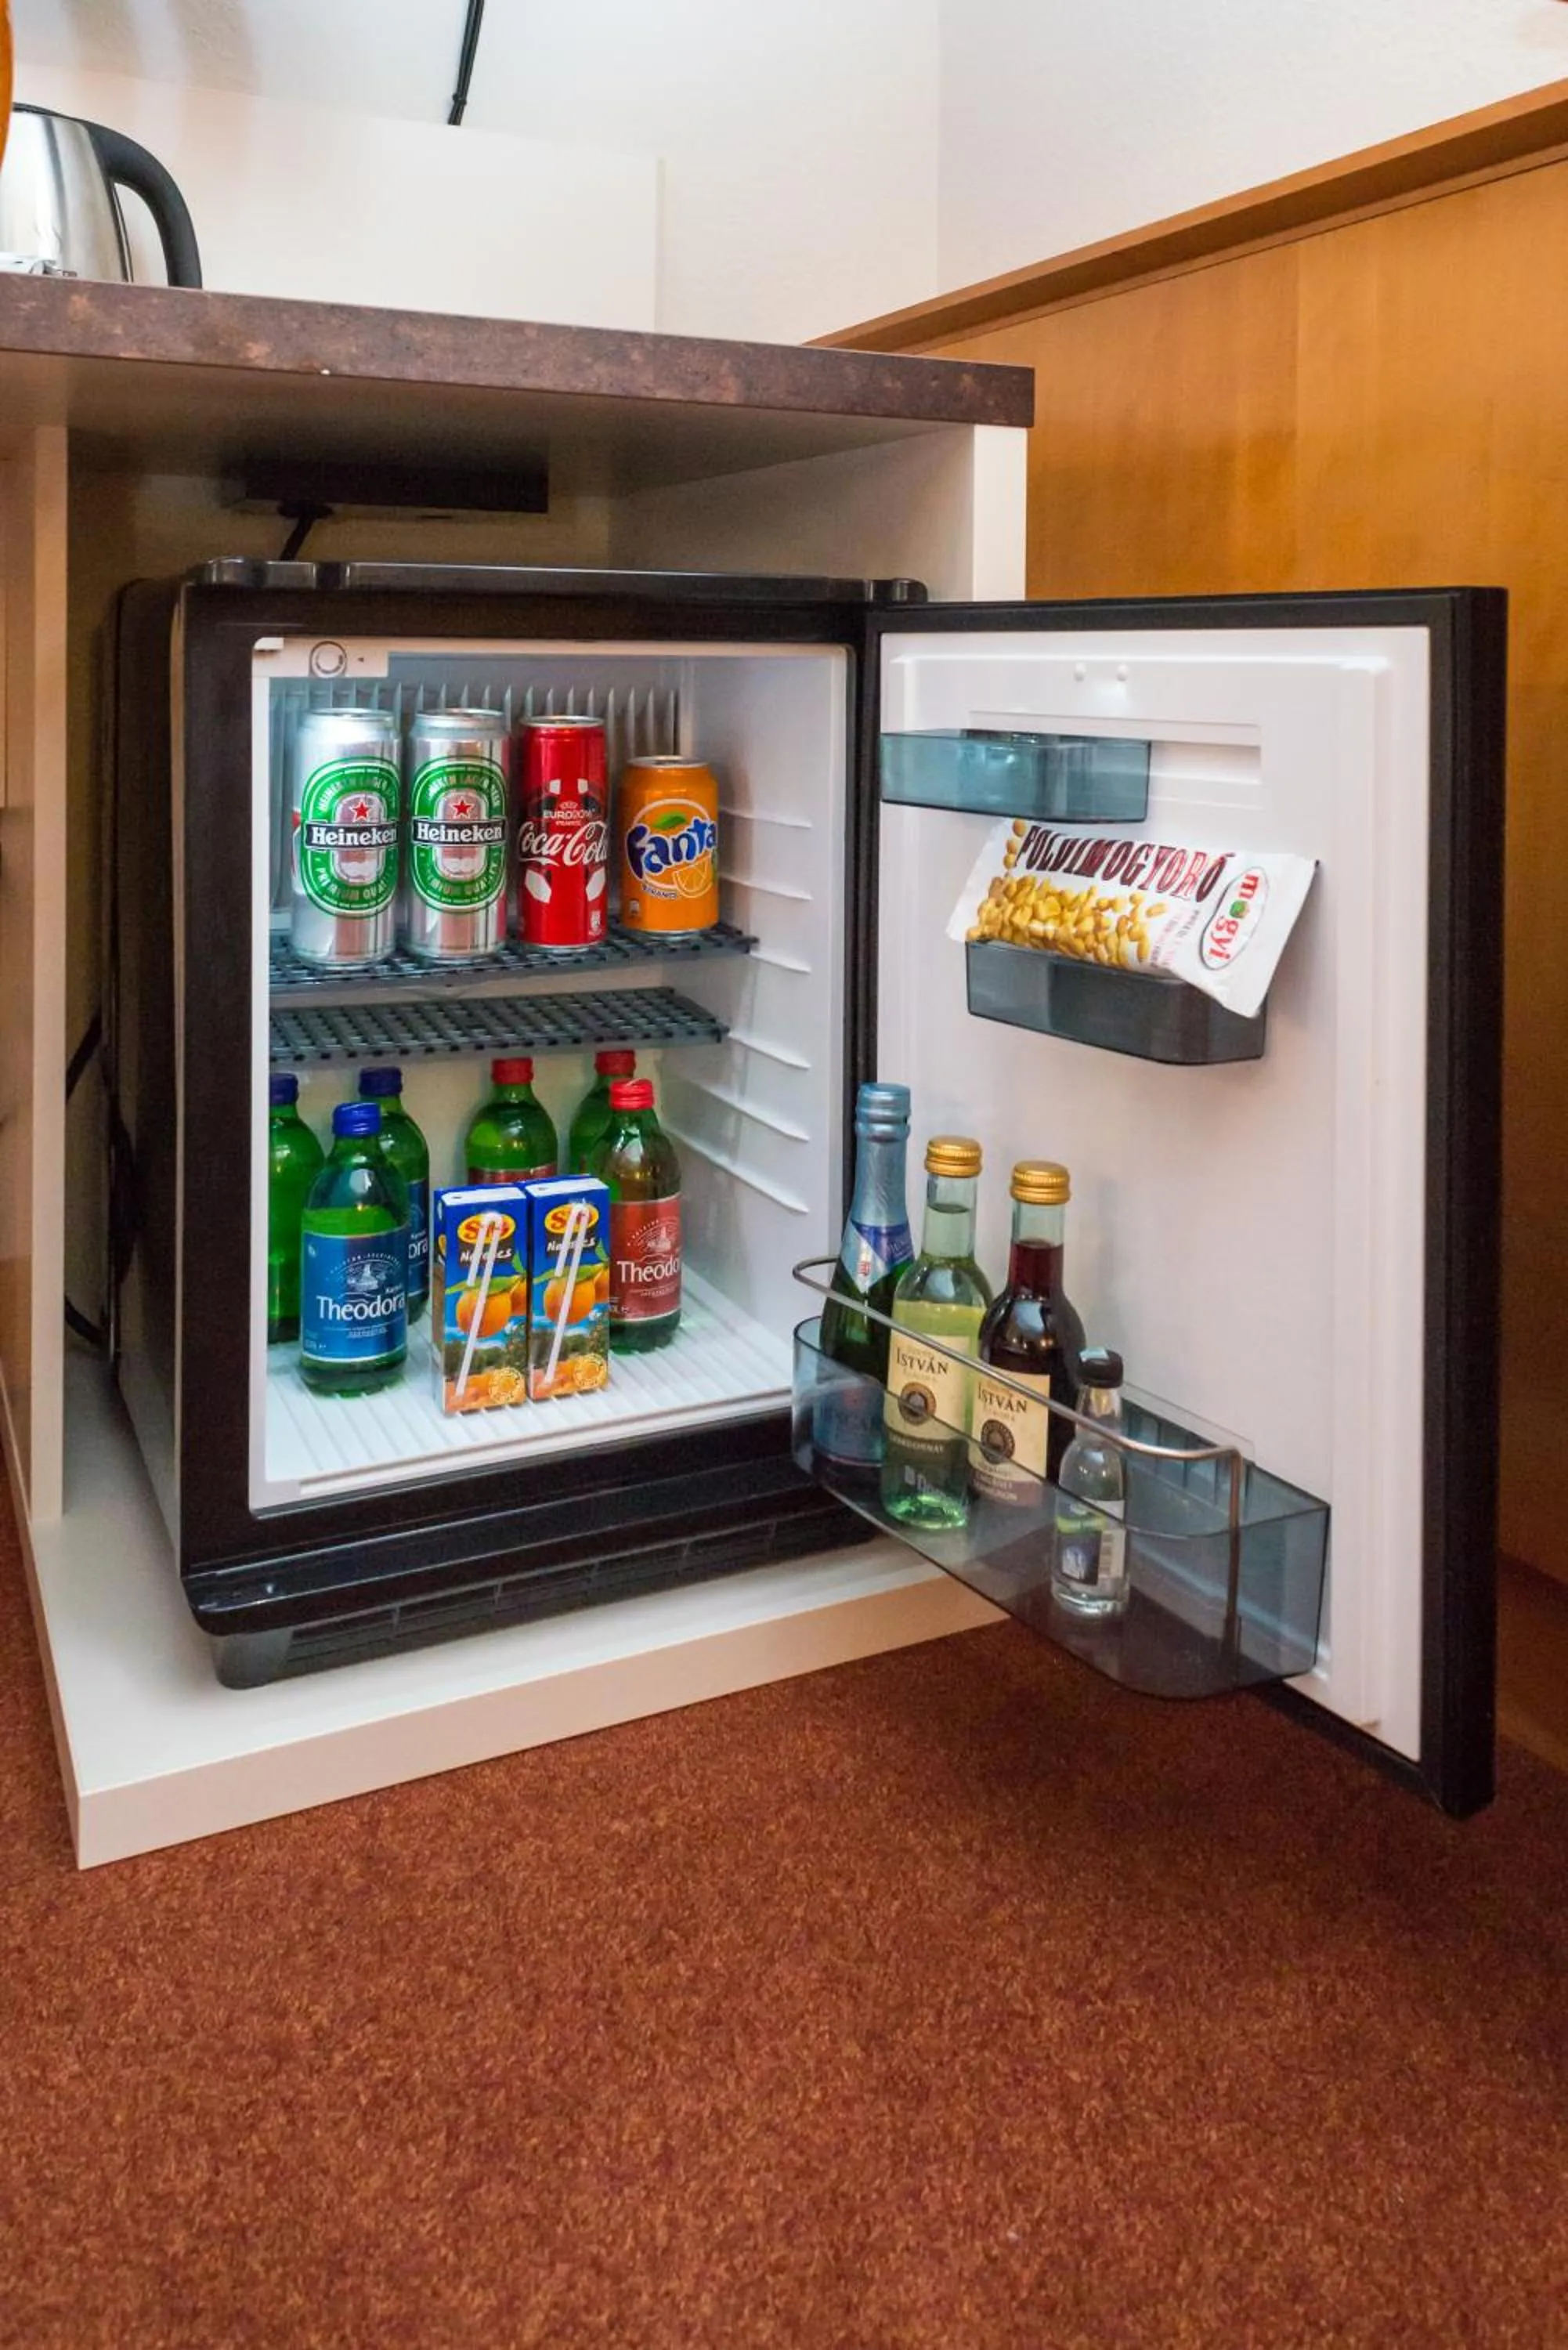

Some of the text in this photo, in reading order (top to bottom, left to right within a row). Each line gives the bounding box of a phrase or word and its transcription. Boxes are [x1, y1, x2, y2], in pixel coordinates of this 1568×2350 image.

[311, 826, 398, 846] Heineken
[416, 822, 503, 843] Heineken
[518, 820, 608, 866] Coca-Cola
[626, 817, 718, 880] Fanta
[616, 1254, 681, 1283] Theodo
[316, 1292, 406, 1321] Theodora
